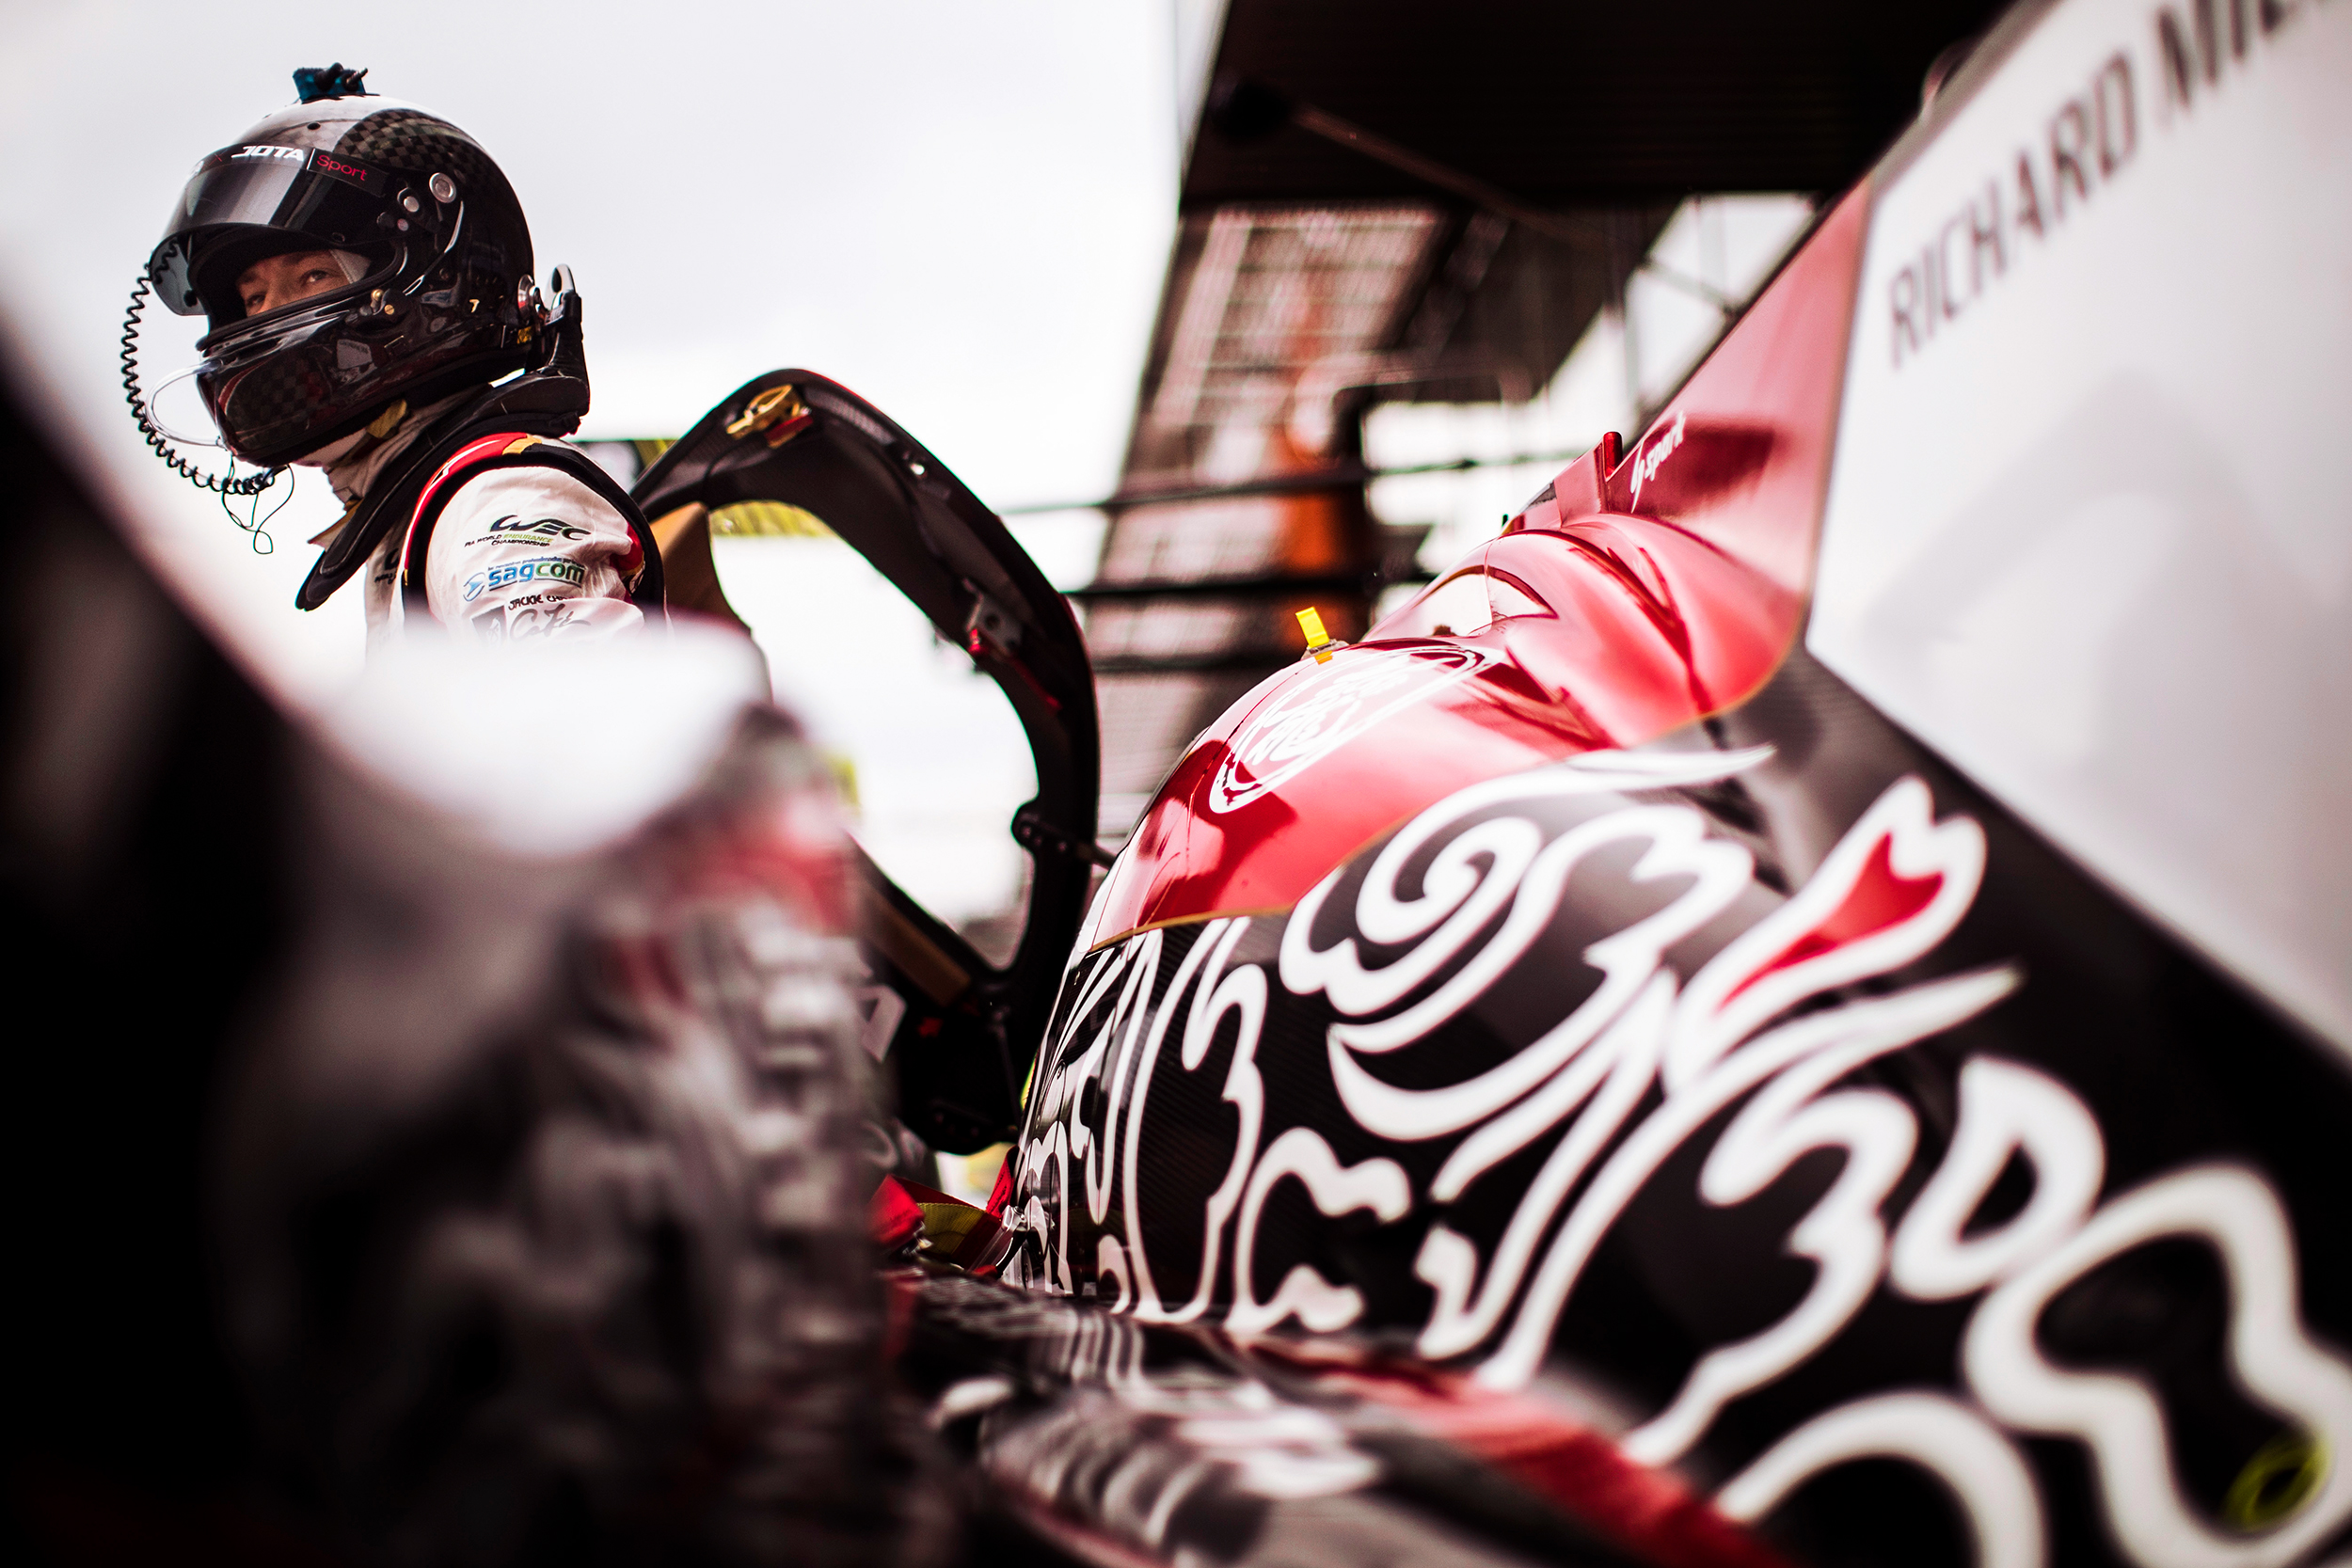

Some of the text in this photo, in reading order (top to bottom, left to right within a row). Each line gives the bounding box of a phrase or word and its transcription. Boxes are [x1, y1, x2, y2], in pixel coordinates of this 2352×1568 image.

[230, 145, 368, 182] JOTA Sport
[1888, 45, 2139, 370] RICHARD
[476, 533, 502, 545] WORLD
[502, 533, 553, 544] ENDURANCE
[489, 515, 592, 541] WEC
[491, 539, 550, 547] CHAMPIONSHIP
[488, 562, 585, 586] sagcom
[508, 594, 544, 610] JACKIE
